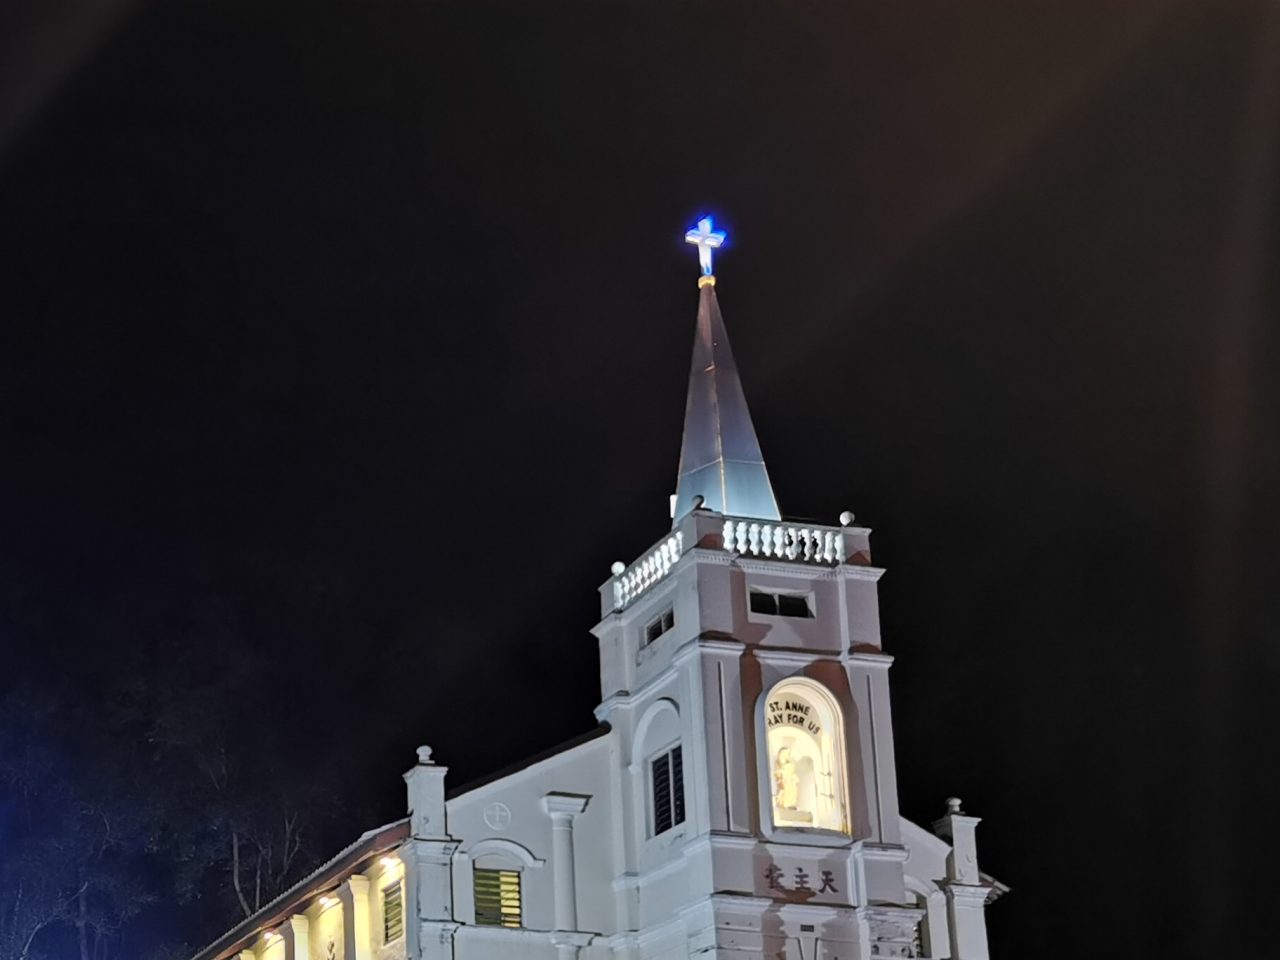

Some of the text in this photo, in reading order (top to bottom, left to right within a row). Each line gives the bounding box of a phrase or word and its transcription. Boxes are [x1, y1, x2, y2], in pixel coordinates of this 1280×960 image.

[768, 700, 810, 716] ST. ANNE
[787, 713, 806, 728] FOR
[807, 720, 821, 735] US
